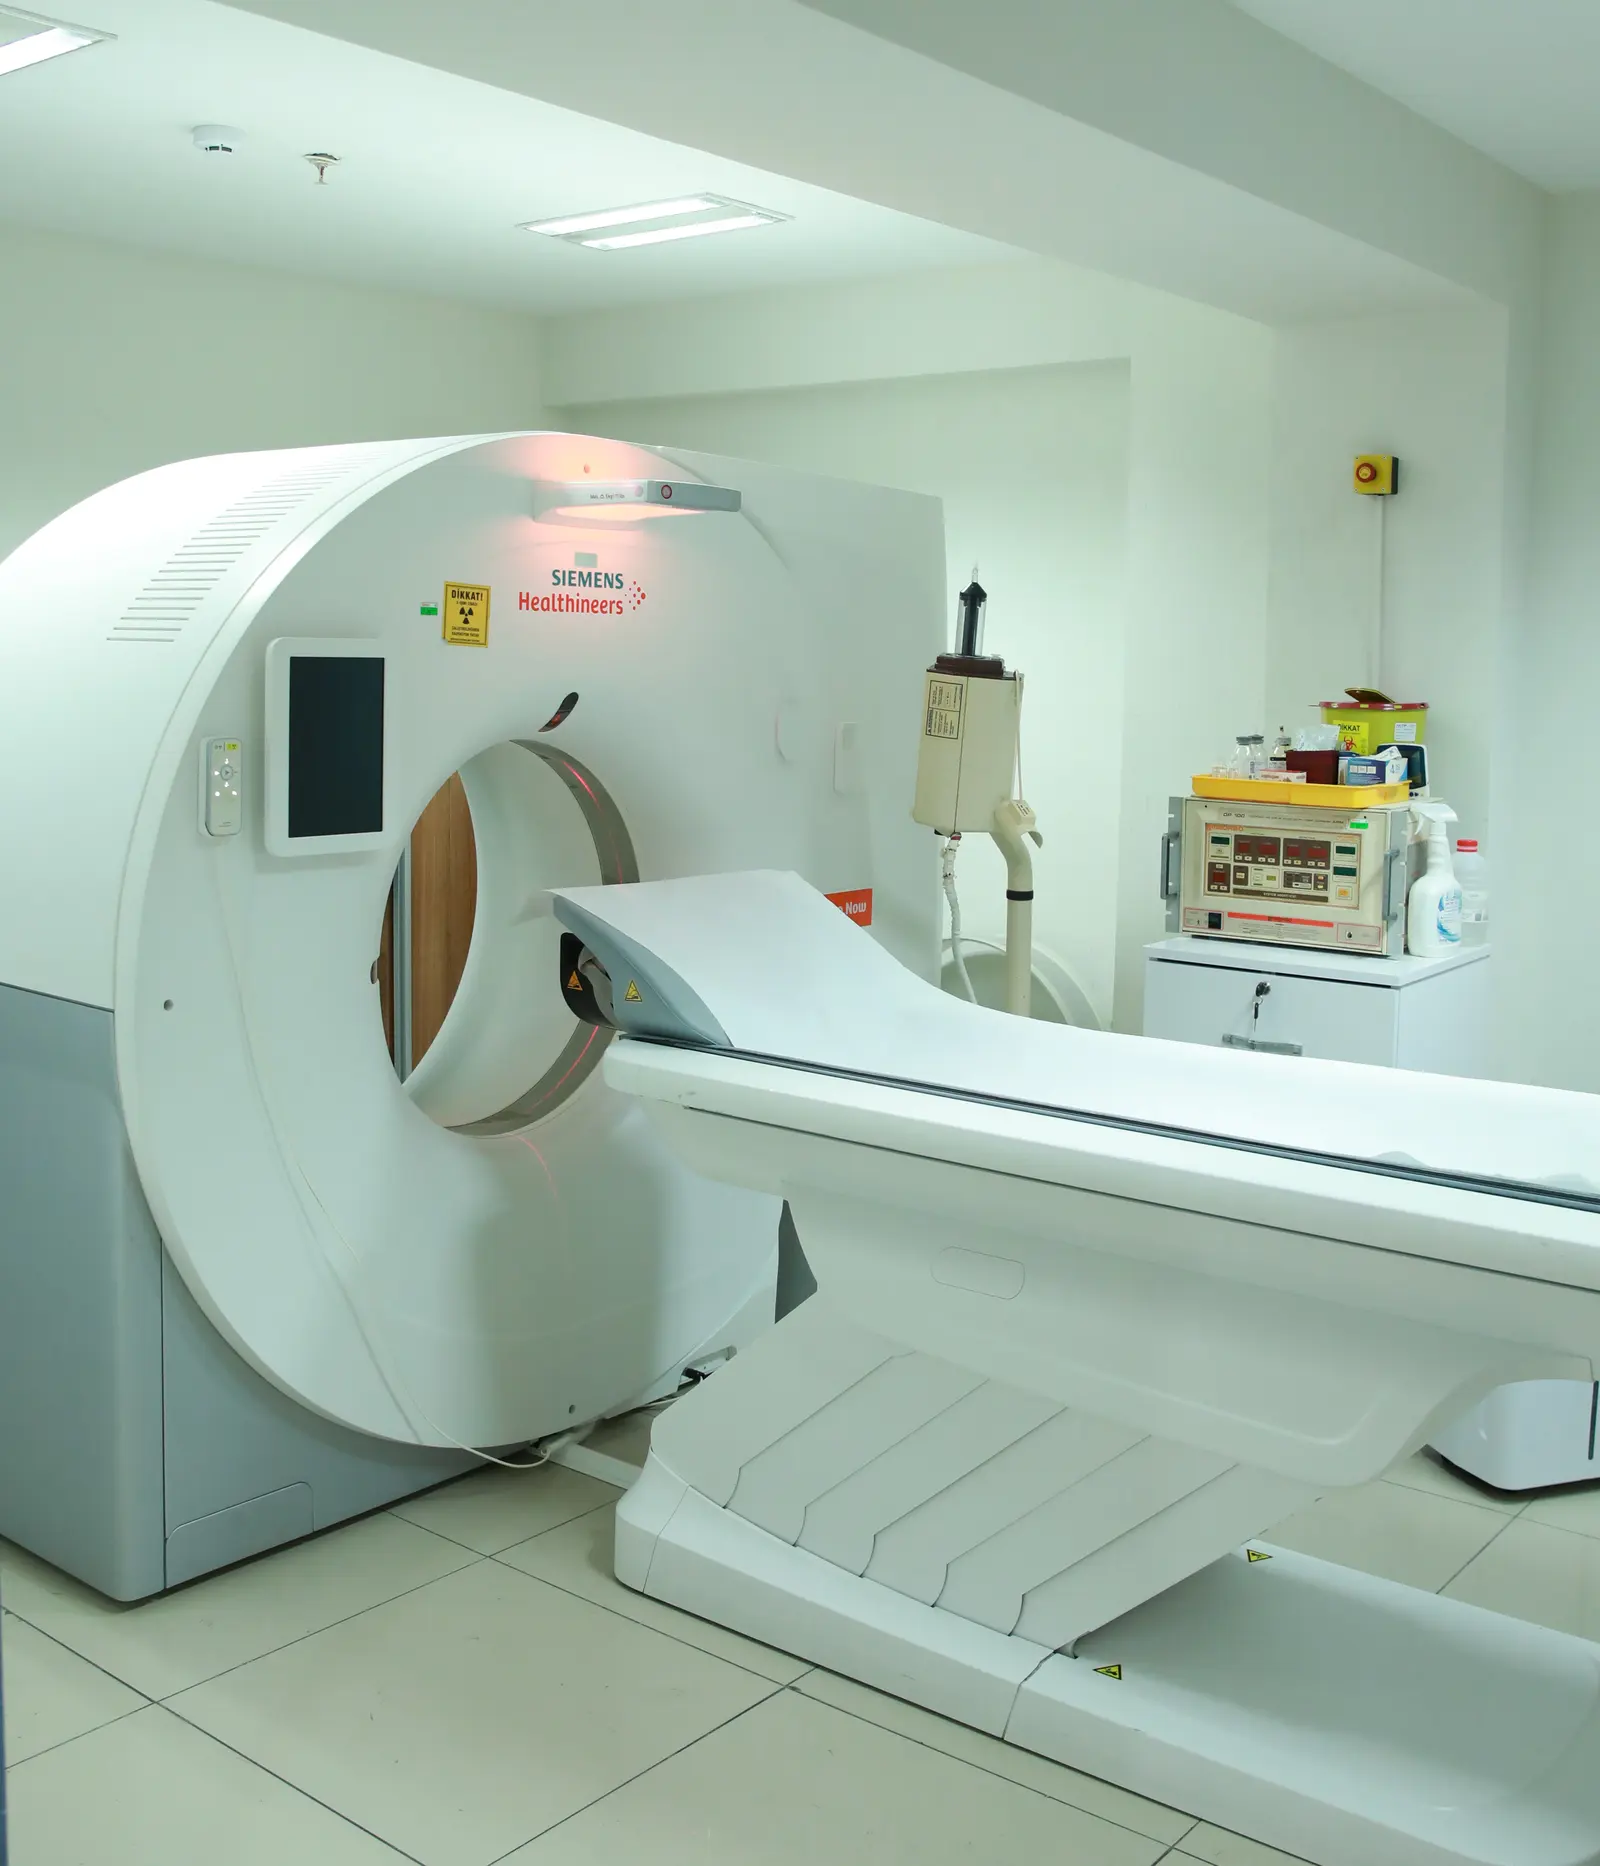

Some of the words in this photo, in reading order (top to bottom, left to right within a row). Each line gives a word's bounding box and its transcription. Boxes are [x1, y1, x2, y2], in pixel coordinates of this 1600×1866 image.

[552, 569, 624, 589] SIEMENS
[451, 588, 483, 602] DİKKAT!
[519, 591, 623, 615] Healthineers
[845, 901, 867, 915] Now
